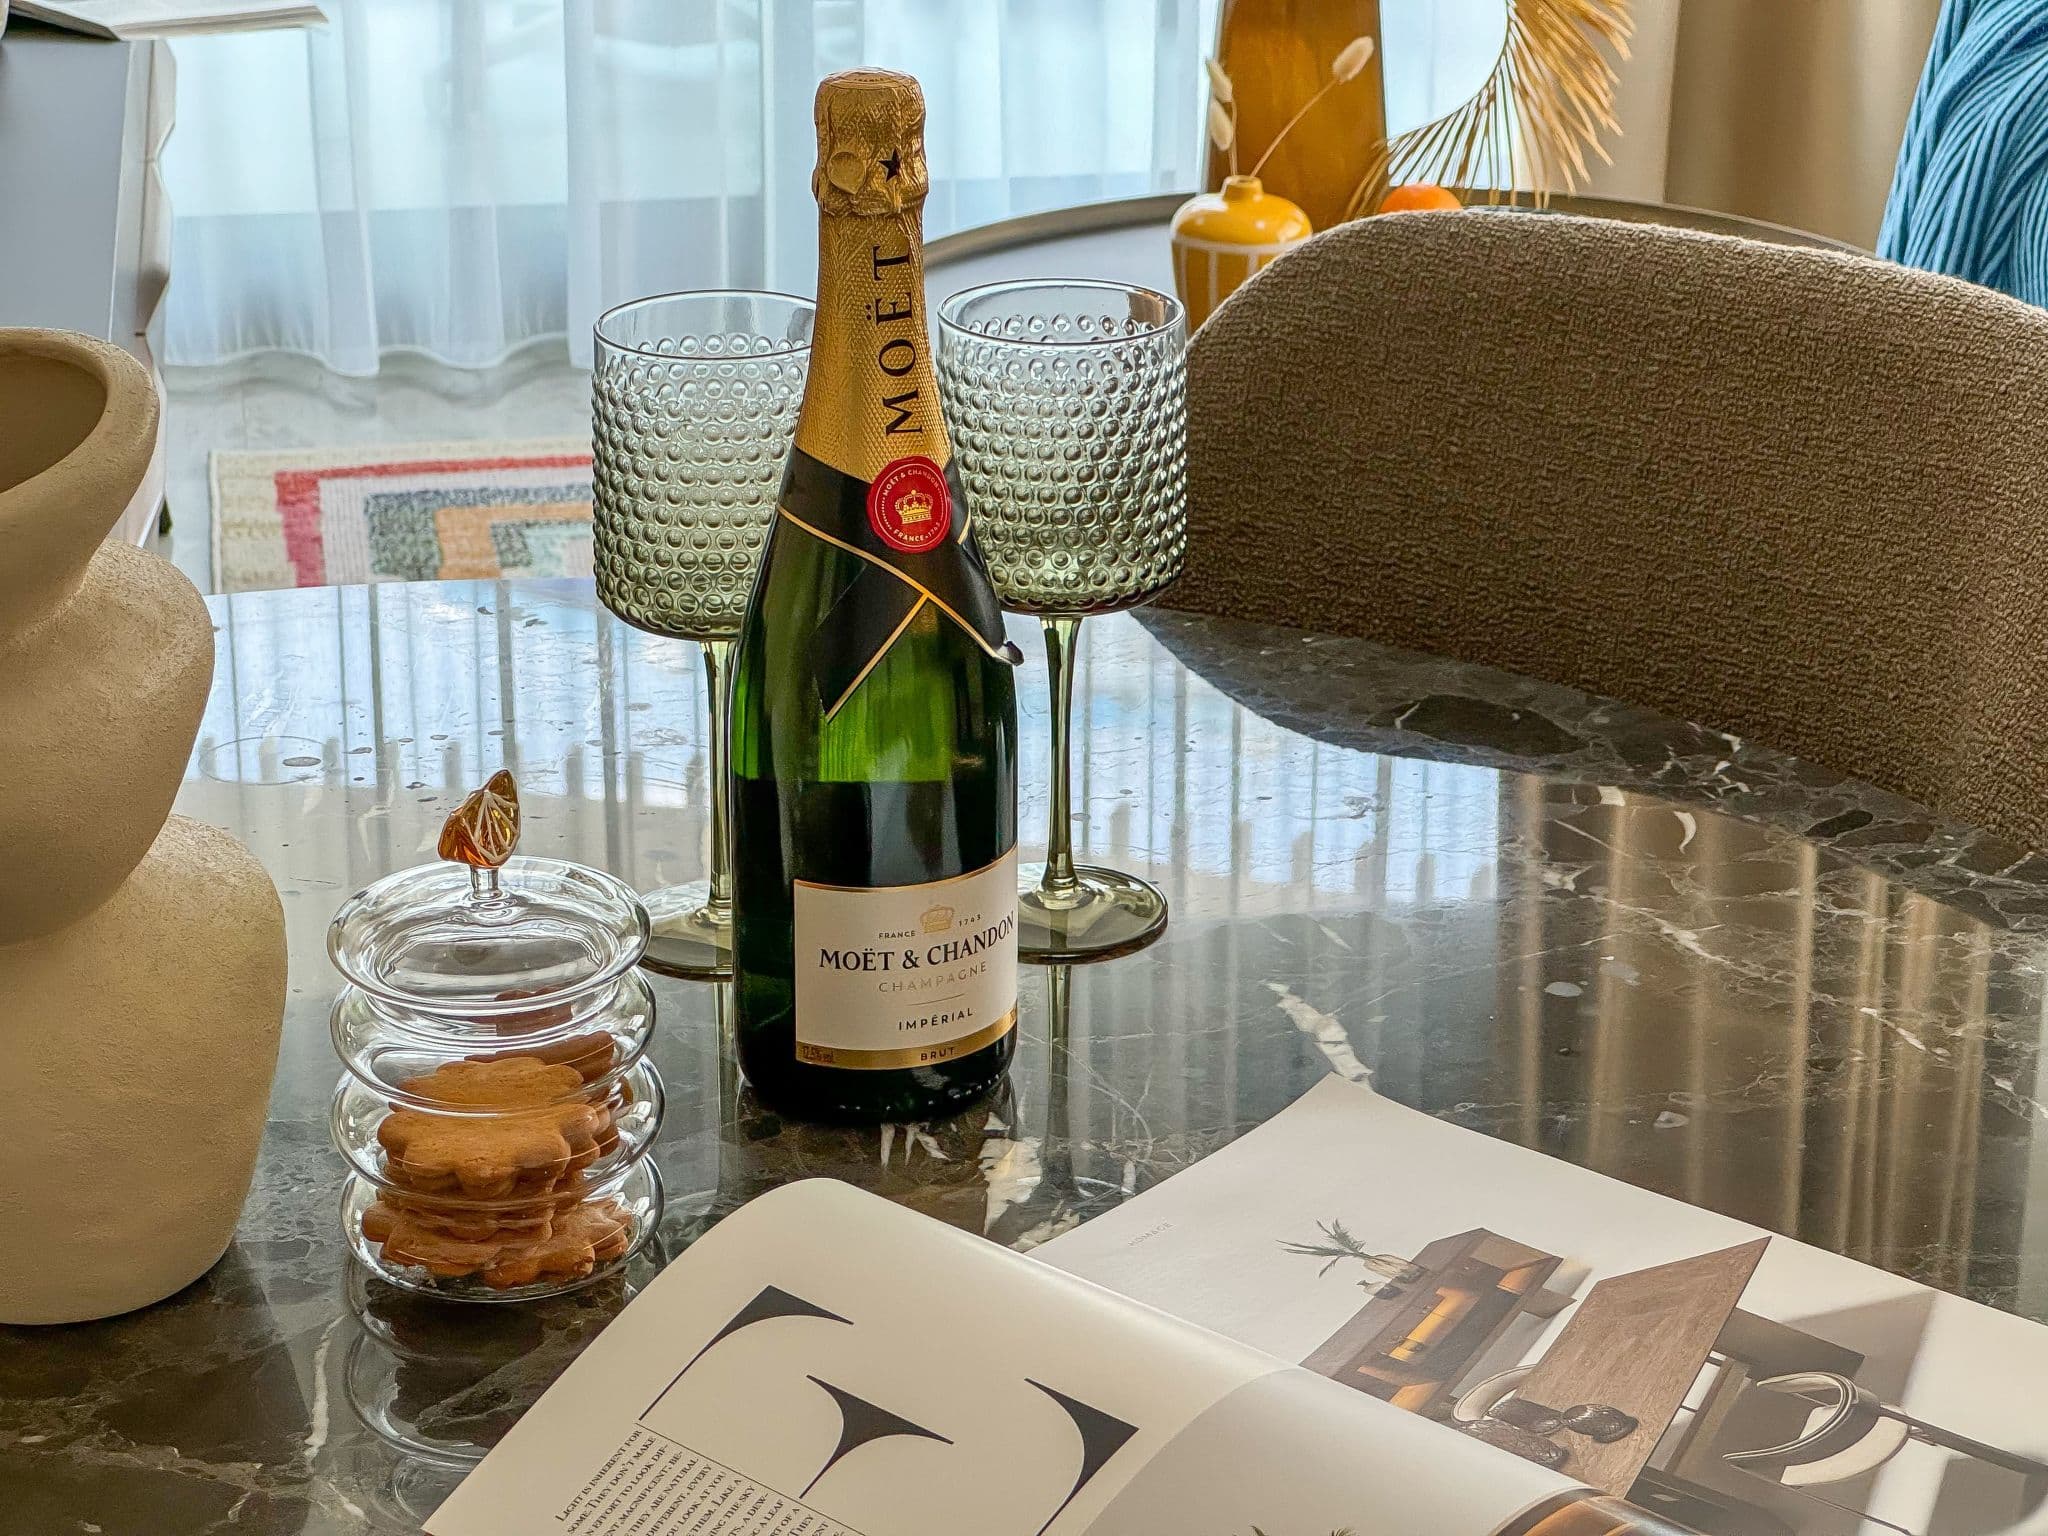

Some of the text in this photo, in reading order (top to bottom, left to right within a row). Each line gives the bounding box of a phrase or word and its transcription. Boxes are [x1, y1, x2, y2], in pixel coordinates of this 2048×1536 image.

[866, 245, 923, 437] MOËT
[908, 468, 940, 489] CHANDON
[893, 529, 925, 542] FRANCE
[819, 910, 1014, 971] MOËT & CHANDON
[878, 913, 982, 939] FRANCE 1743
[878, 960, 988, 993] CHAMPAGNE
[920, 1046, 956, 1061] BRUT
[587, 1448, 627, 1486] INHERENT
[623, 1429, 643, 1446] FOR
[632, 1436, 657, 1459] MAKE
[685, 1464, 714, 1491] EVERY
[590, 1498, 623, 1529] EFFORT
[618, 1484, 634, 1498] TO
[629, 1461, 655, 1485] LOOK
[627, 1456, 701, 1534] THEY ARE NATURAL
[676, 1500, 703, 1525] LOOK
[698, 1489, 712, 1501] AT
[707, 1471, 728, 1489] YOU
[722, 1502, 742, 1520] THE
[737, 1485, 757, 1502] SKY
[762, 1499, 786, 1520] LEAF
[778, 1514, 794, 1527] OF
